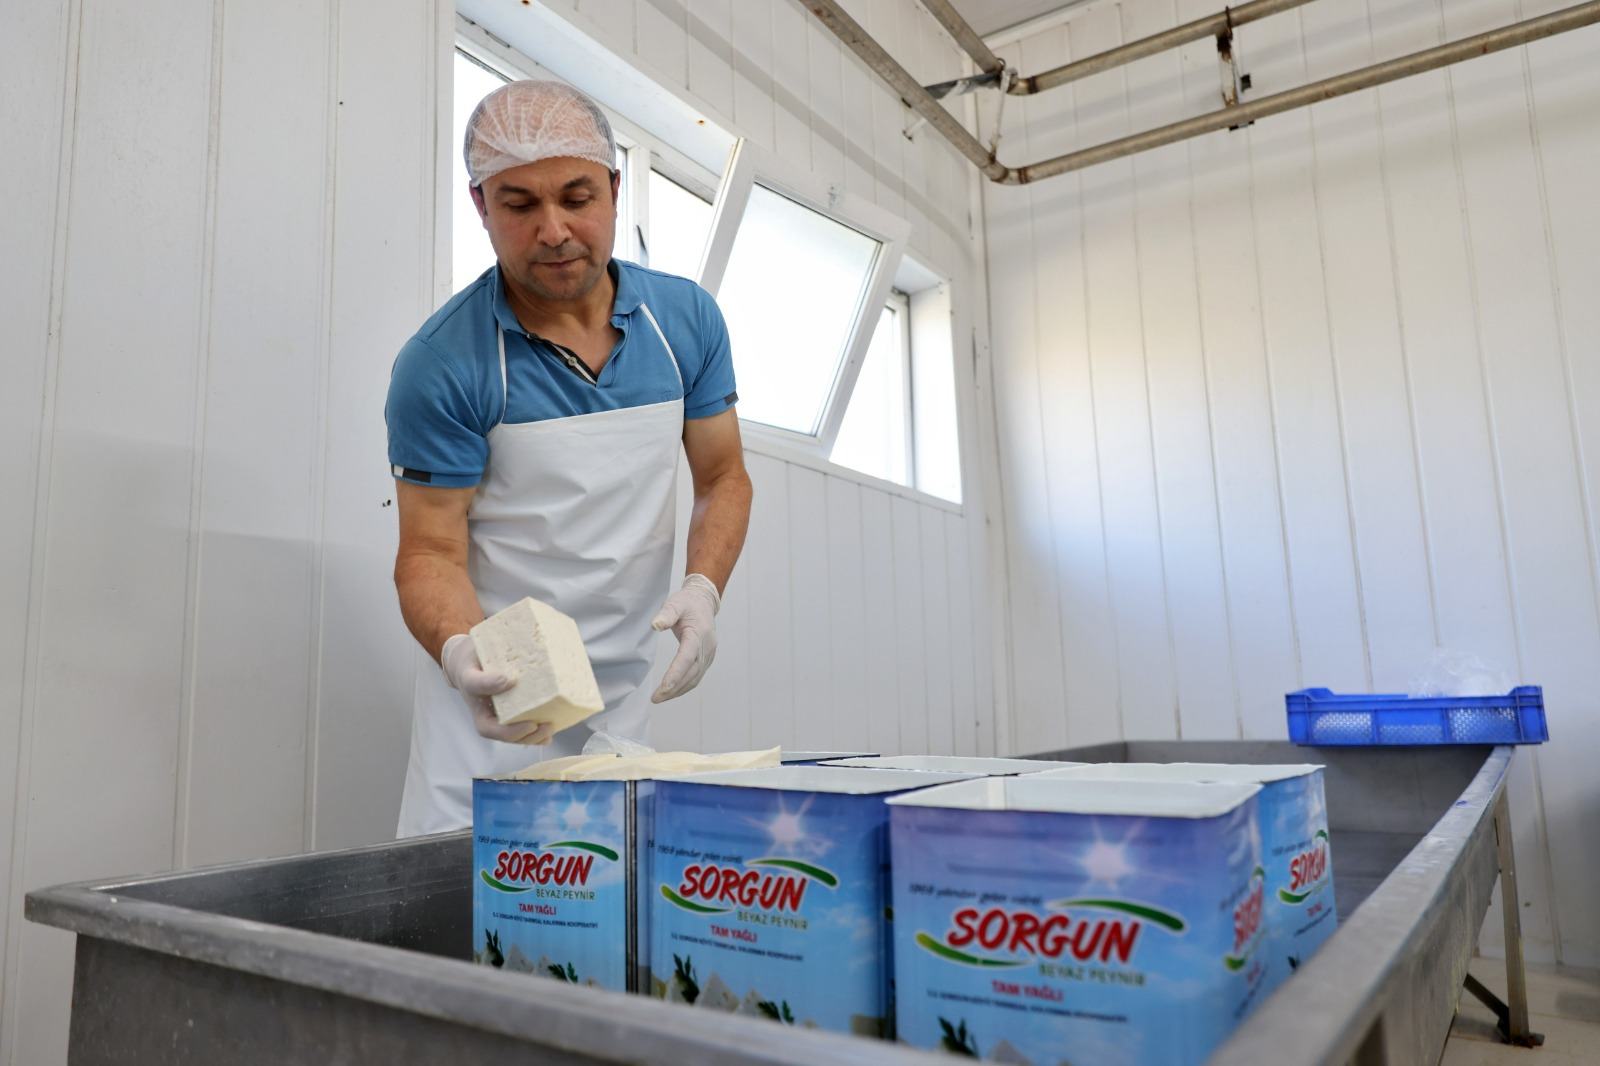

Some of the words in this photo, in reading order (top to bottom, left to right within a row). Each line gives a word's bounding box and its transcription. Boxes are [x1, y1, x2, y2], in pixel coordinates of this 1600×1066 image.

[494, 851, 594, 886] SORGUN
[536, 888, 561, 899] BEYAZ
[563, 889, 596, 900] PEYNİR
[679, 865, 807, 912] SORGUN
[518, 903, 534, 913] TAM
[535, 903, 557, 916] YAĞLI
[737, 910, 767, 926] BEYAZ
[770, 915, 808, 931] PEYNİR
[710, 925, 729, 938] TAM
[731, 927, 757, 943] YAĞLI
[946, 908, 1140, 964] SORGUN
[1038, 963, 1085, 981] BEYAZ
[991, 979, 1020, 996] TAM
[1024, 982, 1064, 1002] YAĞLI
